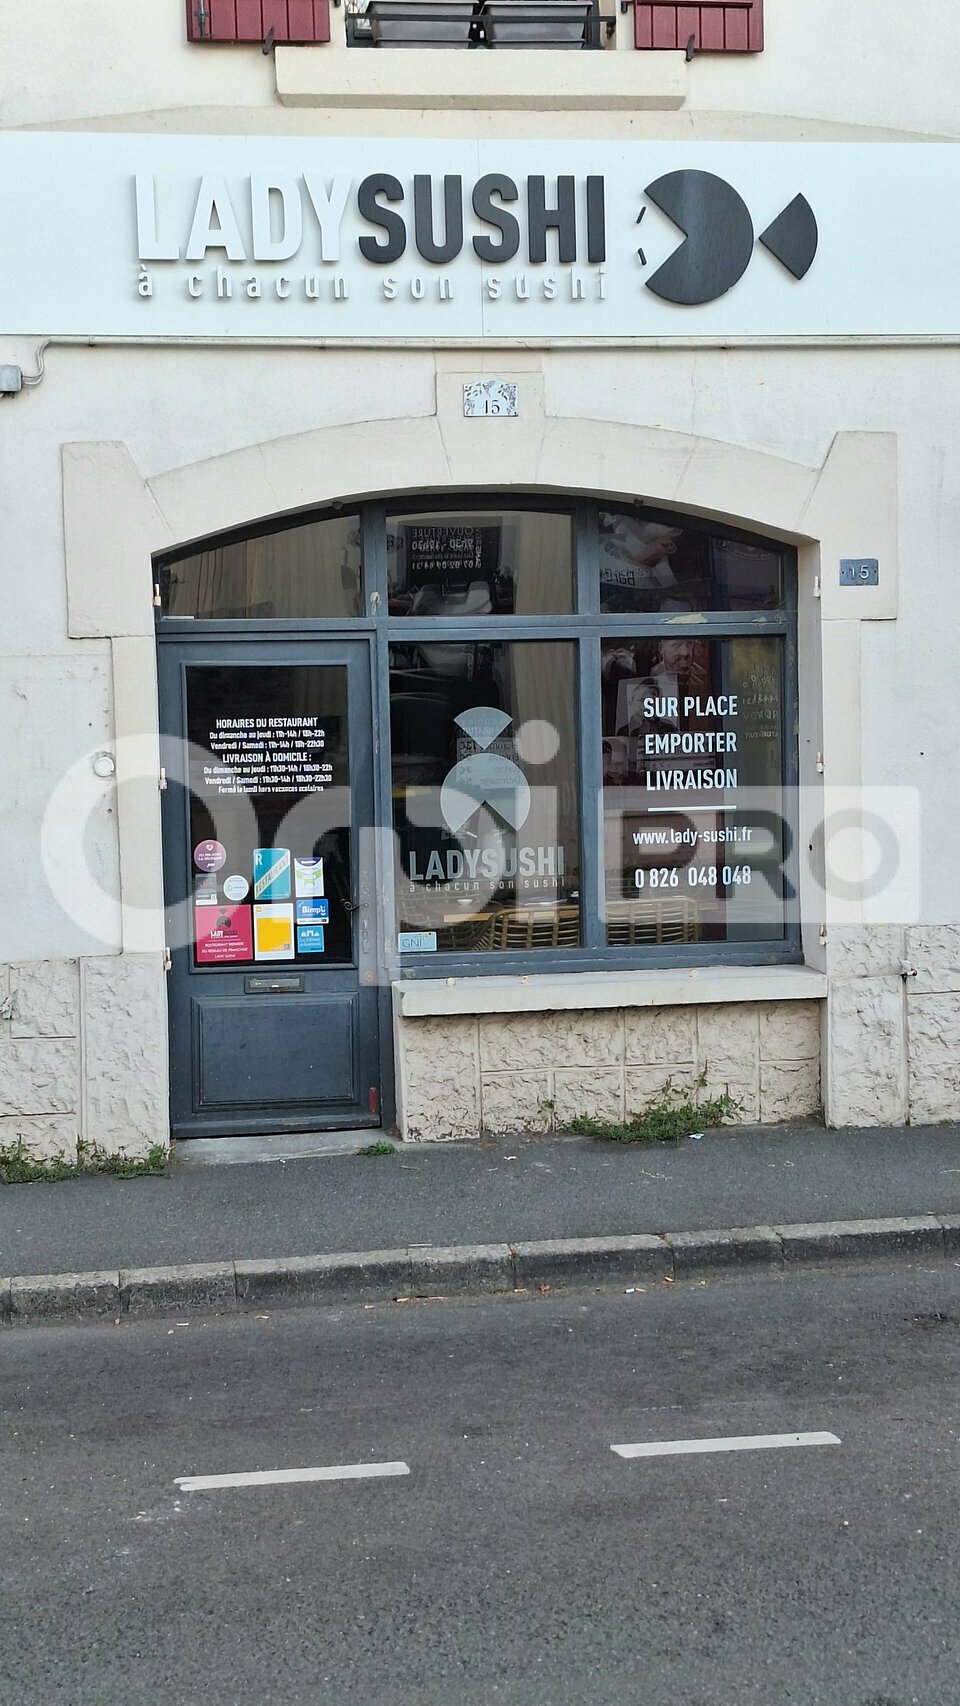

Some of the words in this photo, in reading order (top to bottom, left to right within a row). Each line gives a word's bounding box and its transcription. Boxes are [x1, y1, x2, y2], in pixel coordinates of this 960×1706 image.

[137, 264, 154, 298] à
[187, 266, 349, 300] chacun
[383, 273, 455, 300] son
[488, 266, 606, 300] sushi
[483, 400, 501, 415] 15
[850, 565, 869, 579] 15
[643, 697, 678, 718] SUR
[684, 695, 738, 717] PLACE
[216, 718, 254, 728] HORAIRES
[256, 718, 266, 728] DU
[268, 717, 318, 727] RESTAURANT
[219, 731, 247, 739] dimanche
[257, 731, 271, 739] jeudi
[211, 742, 237, 750] Vendredi
[645, 732, 737, 755] EMPORTER
[223, 753, 263, 763] LIVRAISON
[265, 751, 271, 763] À
[273, 752, 308, 762] DOMICILE
[213, 766, 241, 774] dimanche
[251, 766, 265, 774] jeudi
[205, 777, 231, 785] Vendredi
[236, 776, 258, 784] Samedi
[646, 769, 737, 791] LIVRAISON
[218, 785, 236, 794] Fermé
[258, 785, 271, 793] hors
[632, 827, 752, 846] www.lady-sushi.fr
[255, 853, 263, 866] R
[409, 846, 565, 881] LADYSUSHI
[635, 869, 644, 888] 0
[650, 867, 679, 888] 826
[688, 866, 717, 886] 048
[722, 865, 751, 885] 048
[409, 881, 415, 892] à
[426, 878, 479, 891] chacun
[489, 879, 514, 890] son
[524, 876, 565, 888] sushi
